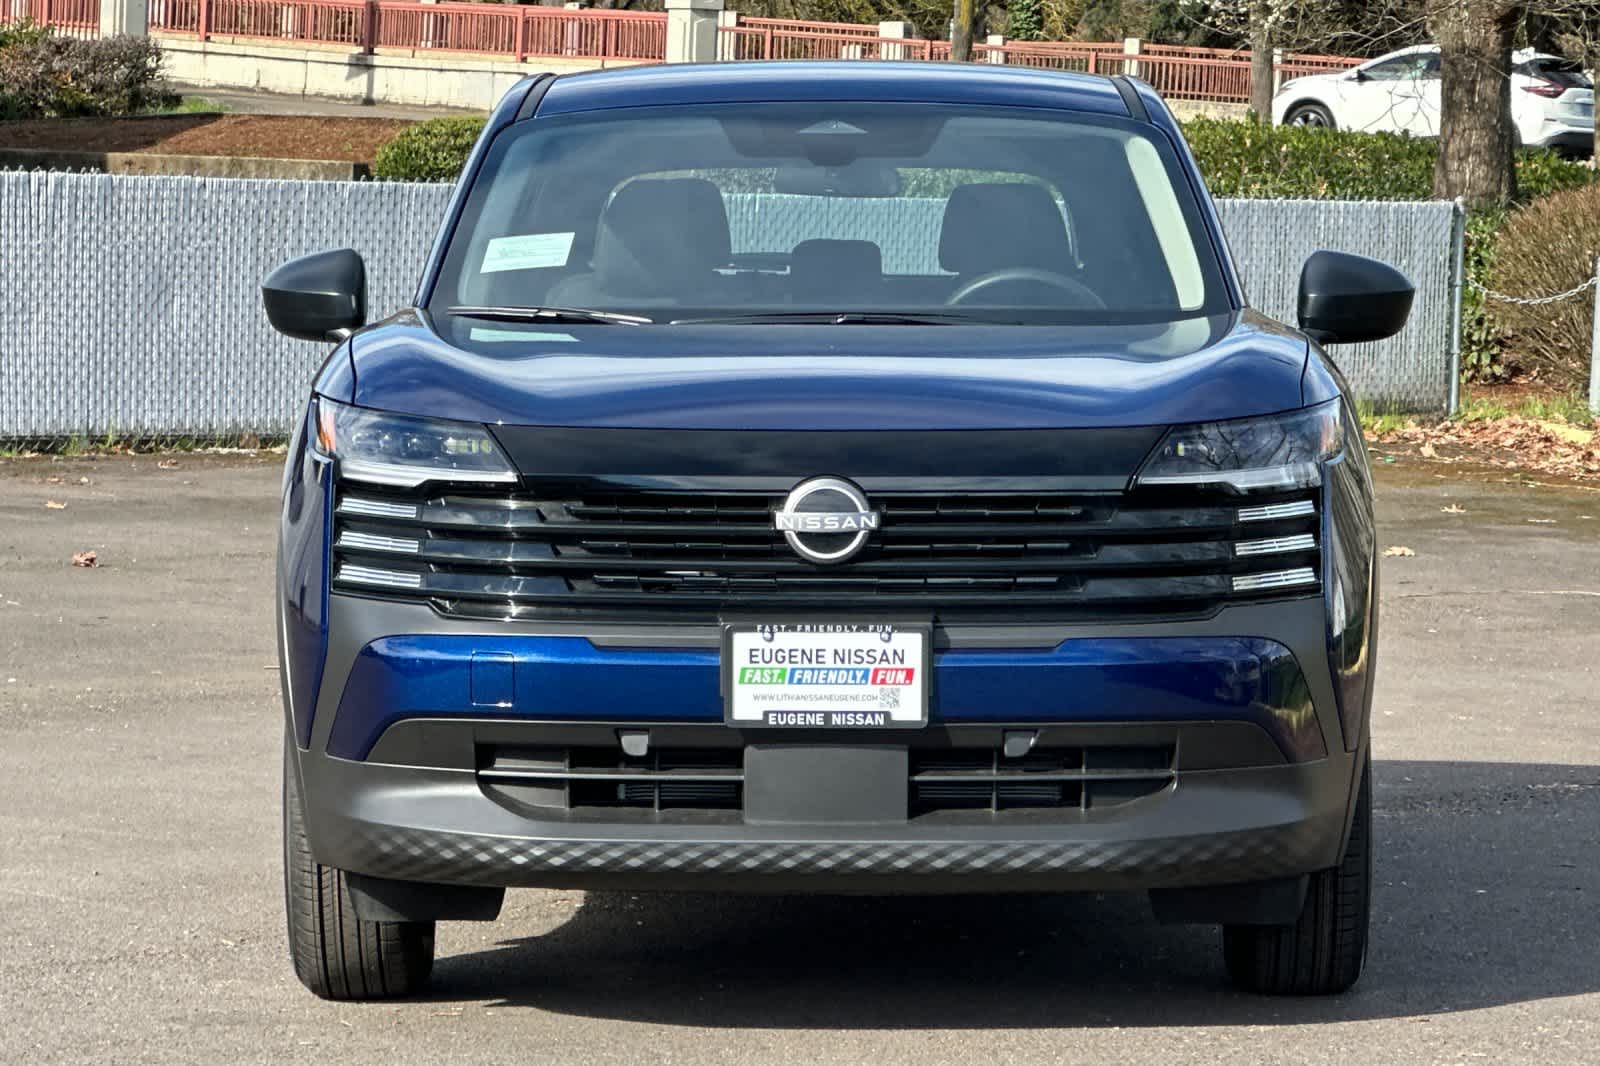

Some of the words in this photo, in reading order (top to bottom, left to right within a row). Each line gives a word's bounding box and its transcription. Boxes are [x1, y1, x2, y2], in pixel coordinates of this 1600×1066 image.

[779, 515, 876, 529] NISSAN
[748, 648, 827, 665] EUGENE
[833, 648, 905, 665] NISSAN
[743, 669, 783, 684] FAST.
[792, 669, 867, 684] FRIENDLY.
[876, 669, 911, 684] FUN.
[768, 713, 825, 725] EUGENE
[831, 713, 885, 725] NISSAN
